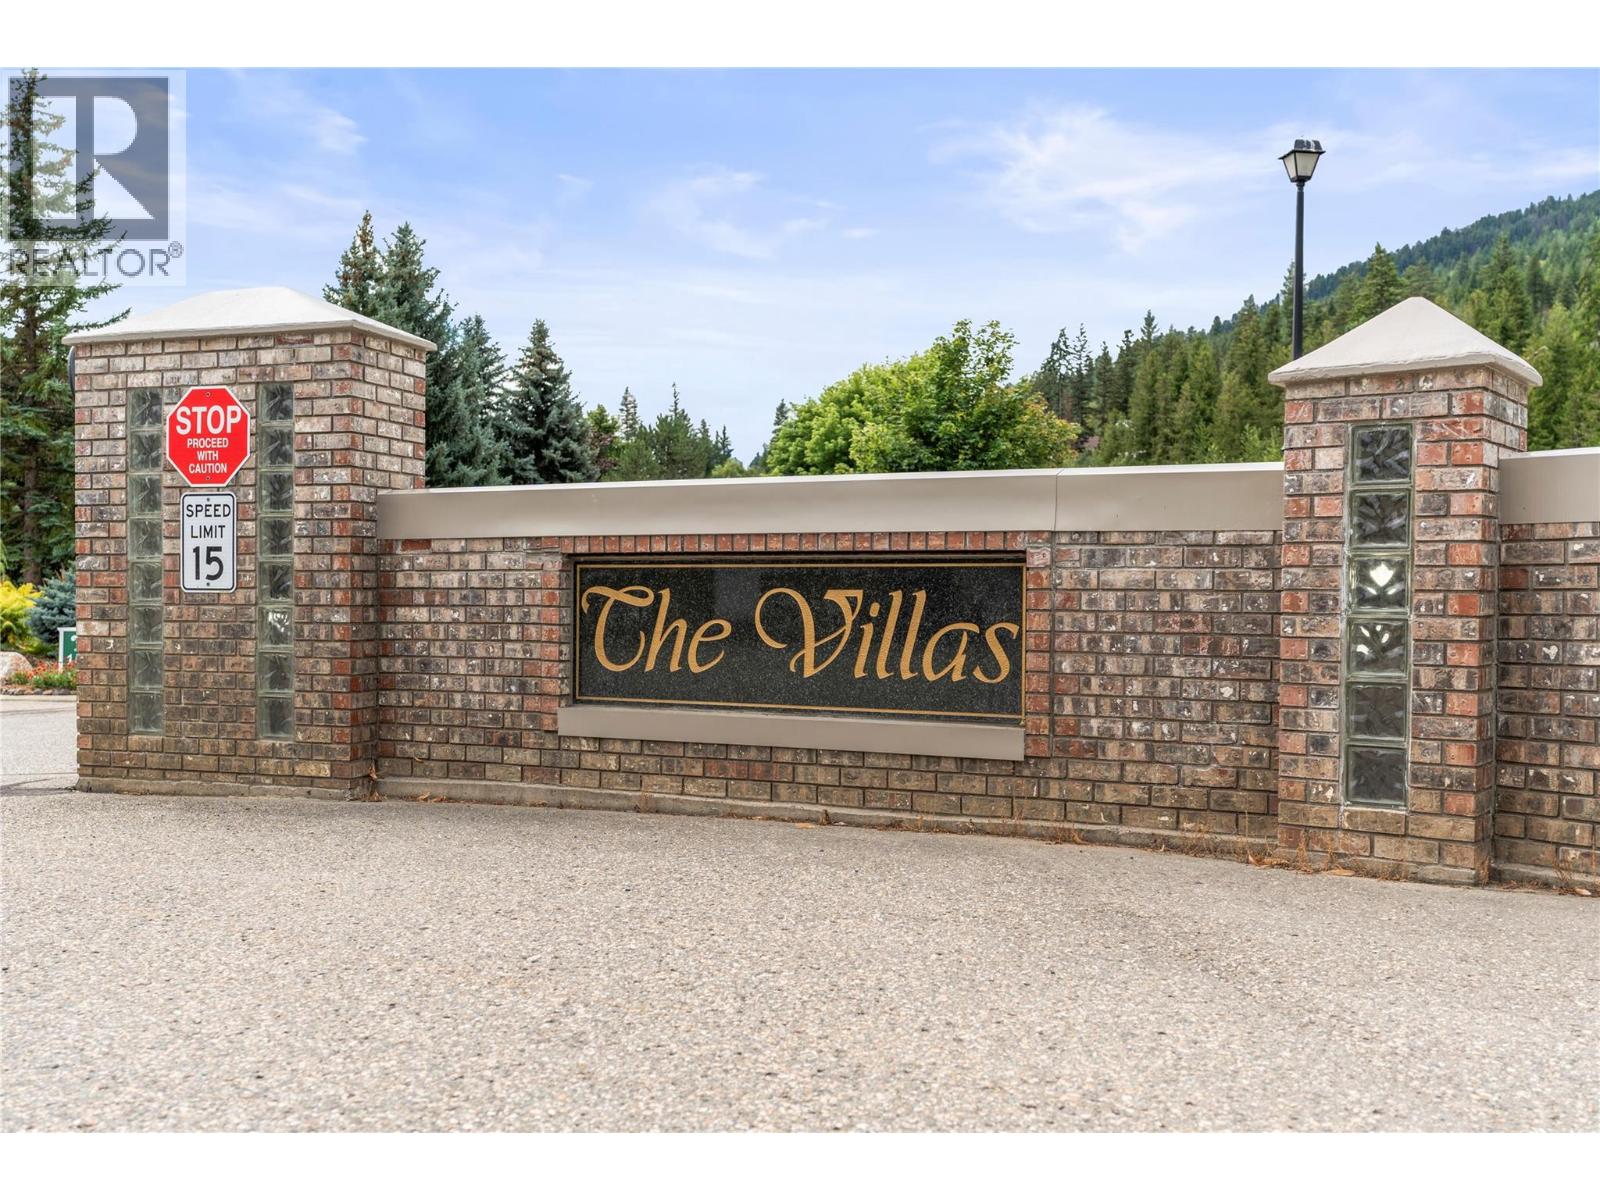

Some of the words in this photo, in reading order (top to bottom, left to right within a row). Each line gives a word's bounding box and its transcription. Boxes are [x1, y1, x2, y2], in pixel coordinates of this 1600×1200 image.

[175, 405, 242, 436] STOP
[187, 437, 229, 449] PROCEED
[197, 450, 219, 461] WITH
[188, 463, 227, 475] CAUTION
[186, 504, 231, 518] SPEED
[190, 525, 226, 539] LIMIT
[192, 546, 224, 581] 15
[581, 586, 732, 674] The
[754, 586, 1020, 684] Villas
